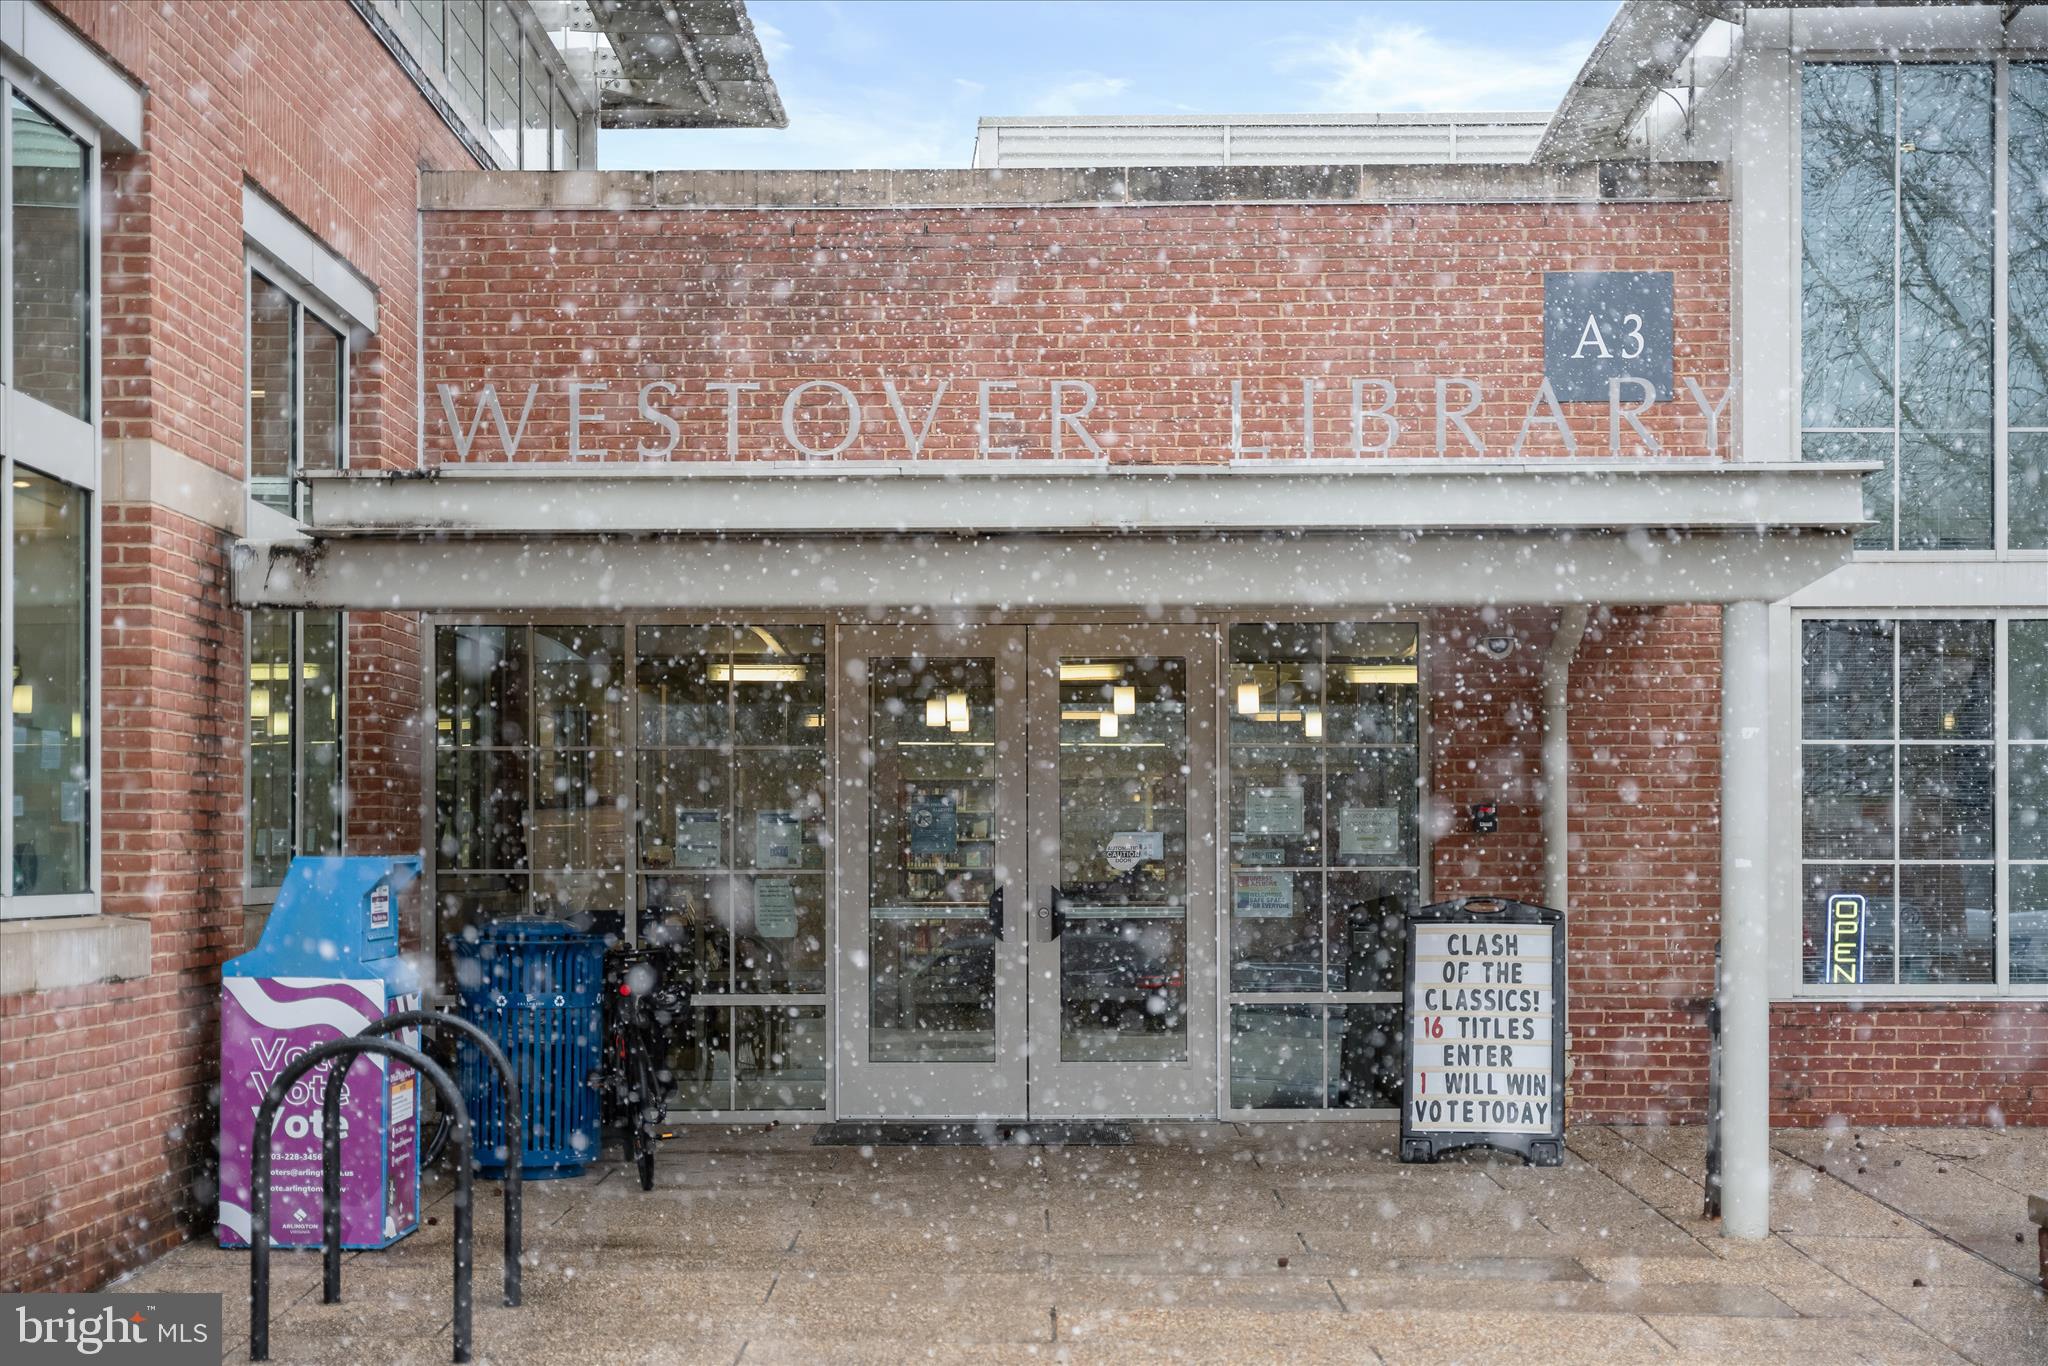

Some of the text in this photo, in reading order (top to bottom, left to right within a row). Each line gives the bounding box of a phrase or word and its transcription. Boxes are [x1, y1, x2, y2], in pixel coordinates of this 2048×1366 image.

[1571, 313, 1645, 360] A3
[436, 376, 1740, 460] WESTOVER LIBRARY
[1447, 934, 1518, 956] CLASH
[1834, 901, 1857, 983] OPEN
[1443, 961, 1523, 984] OF THE
[1425, 989, 1540, 1011] CLASSICS!
[1424, 1016, 1535, 1039] 16 TITLES
[1444, 1045, 1513, 1067] ENTER
[1445, 1073, 1498, 1094] WILL
[1506, 1073, 1546, 1096] WIN
[270, 1153, 323, 1161] 03-228-3456
